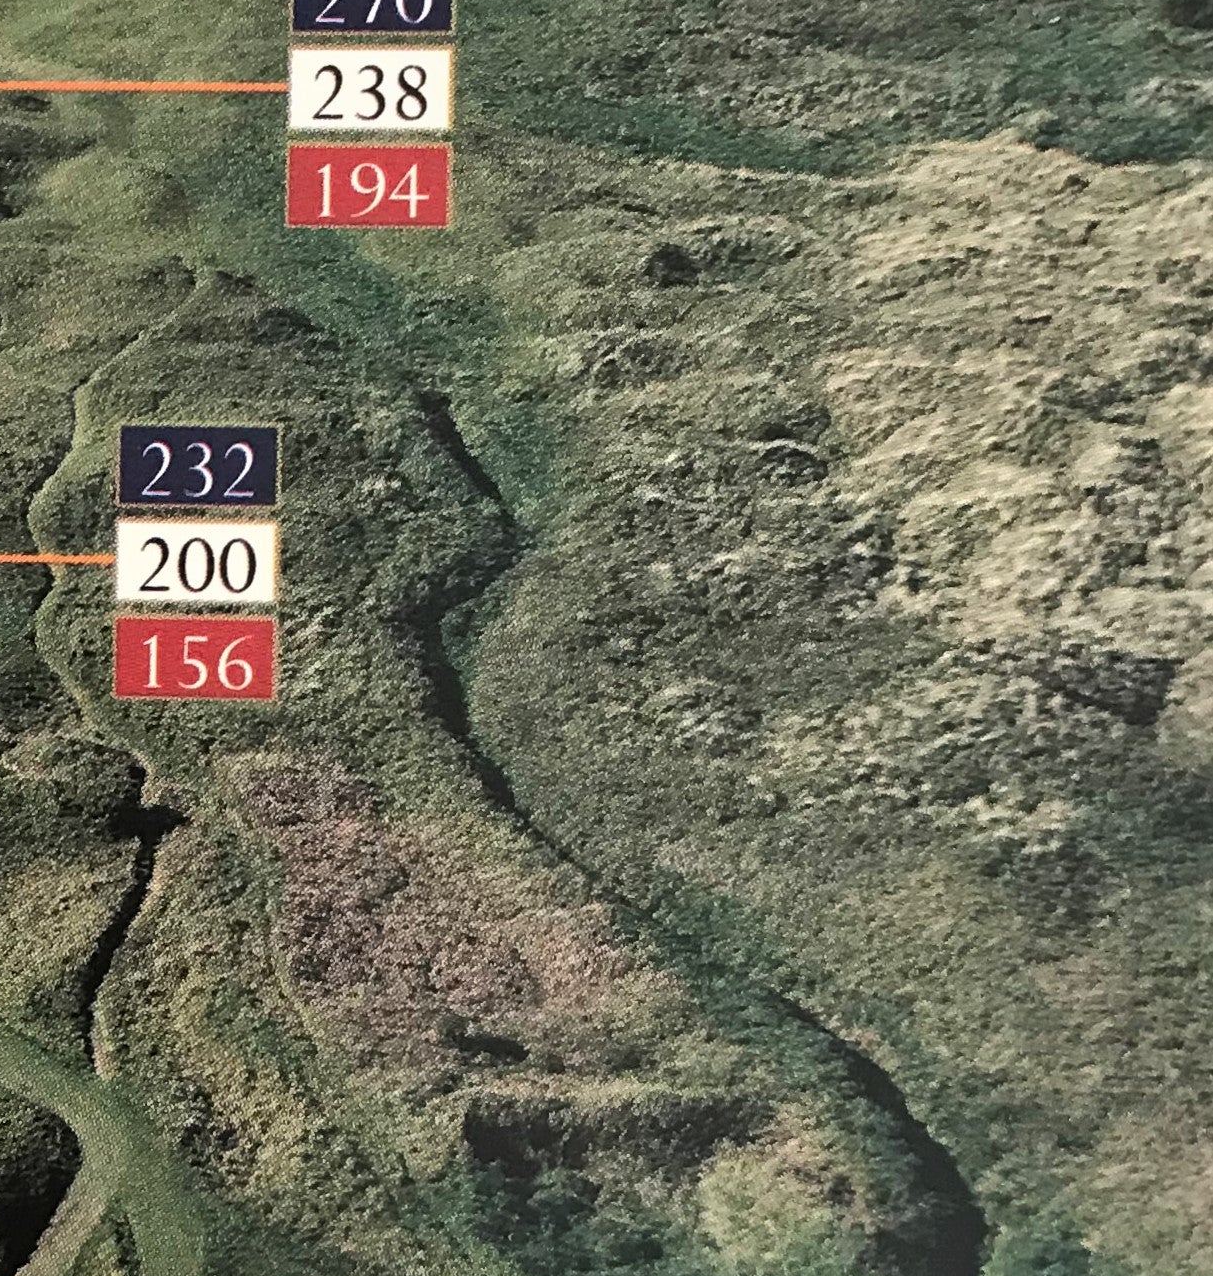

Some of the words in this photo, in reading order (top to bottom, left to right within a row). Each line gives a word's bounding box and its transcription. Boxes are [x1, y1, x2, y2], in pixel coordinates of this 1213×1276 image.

[311, 64, 429, 120] 238
[314, 161, 430, 219] 194
[140, 441, 256, 499] 232
[138, 537, 257, 594] 200
[141, 633, 254, 690] 156
